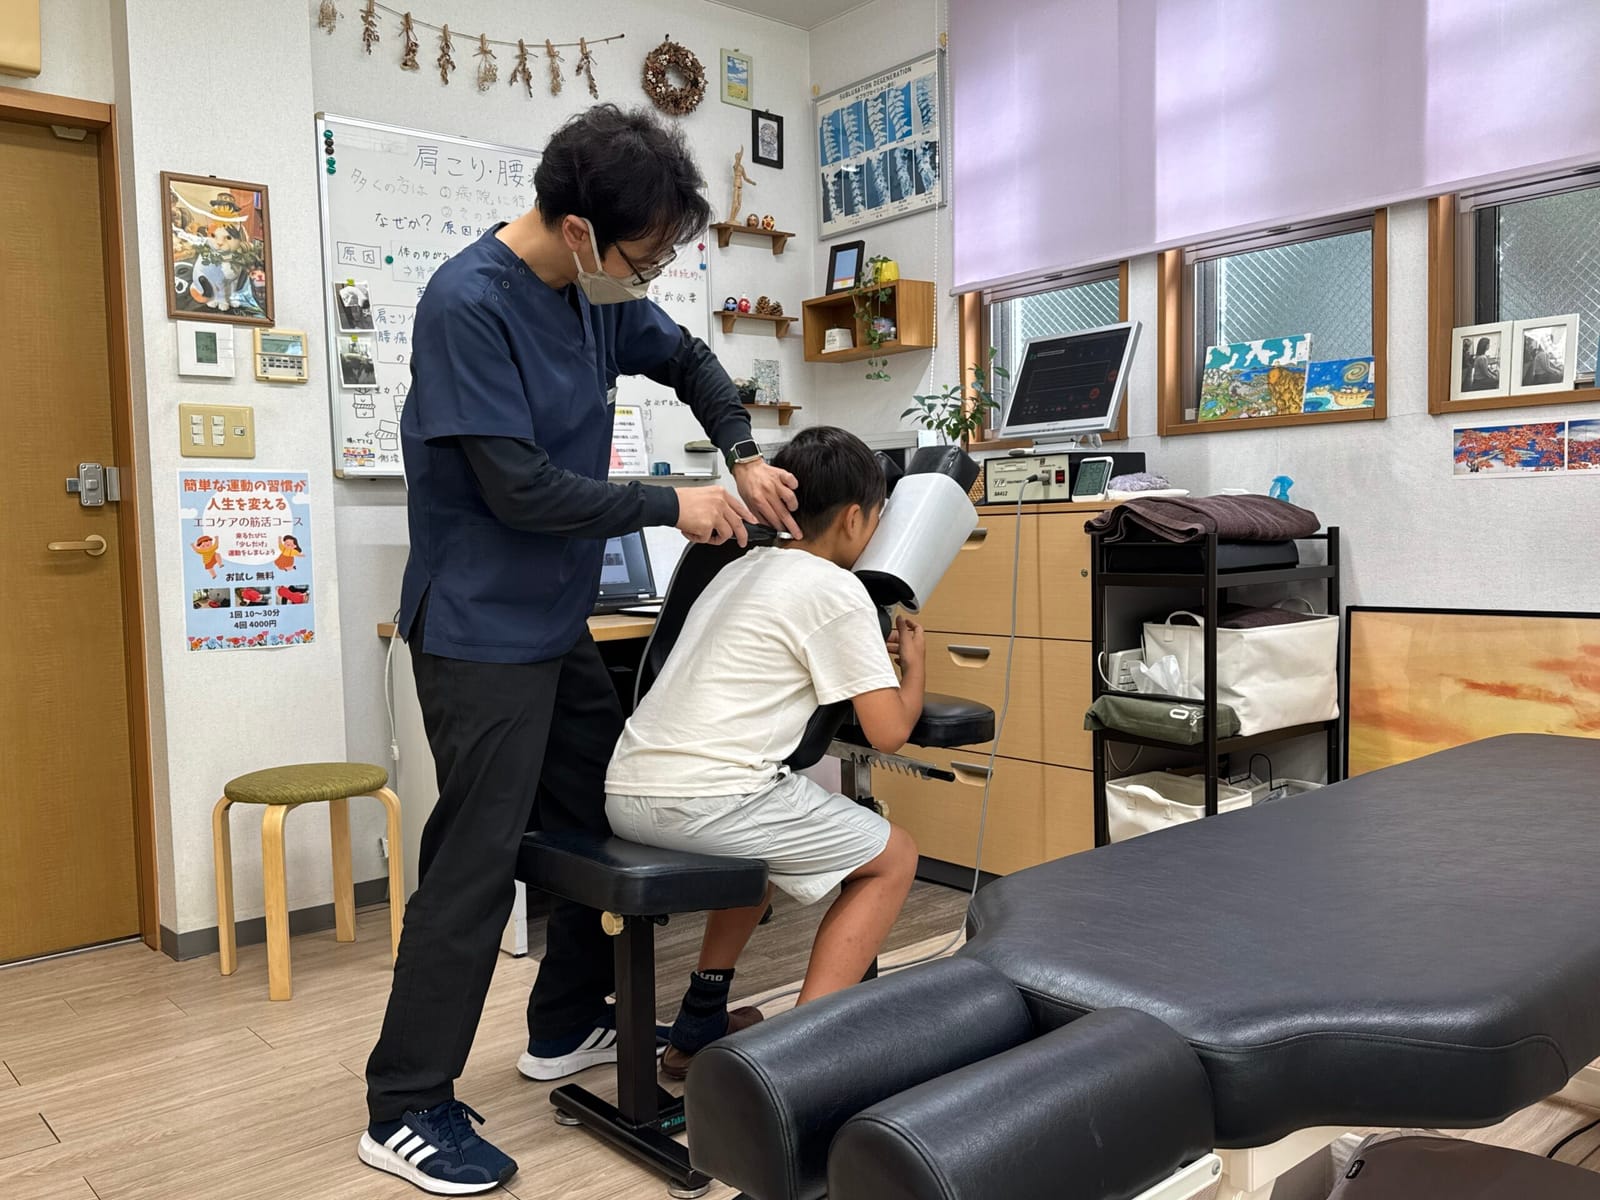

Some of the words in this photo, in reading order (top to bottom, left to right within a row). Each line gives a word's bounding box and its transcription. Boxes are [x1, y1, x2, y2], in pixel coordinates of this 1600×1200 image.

[342, 247, 376, 264] 原因
[184, 478, 307, 493] 簡単な運動の習慣が
[207, 497, 287, 512] 人生を変える
[194, 516, 303, 528] エコケアの筋活コース
[225, 573, 253, 582] お試し
[256, 571, 275, 581] 無料
[230, 610, 243, 619] 1回
[234, 620, 248, 629] 4回
[249, 619, 277, 629] 4000円
